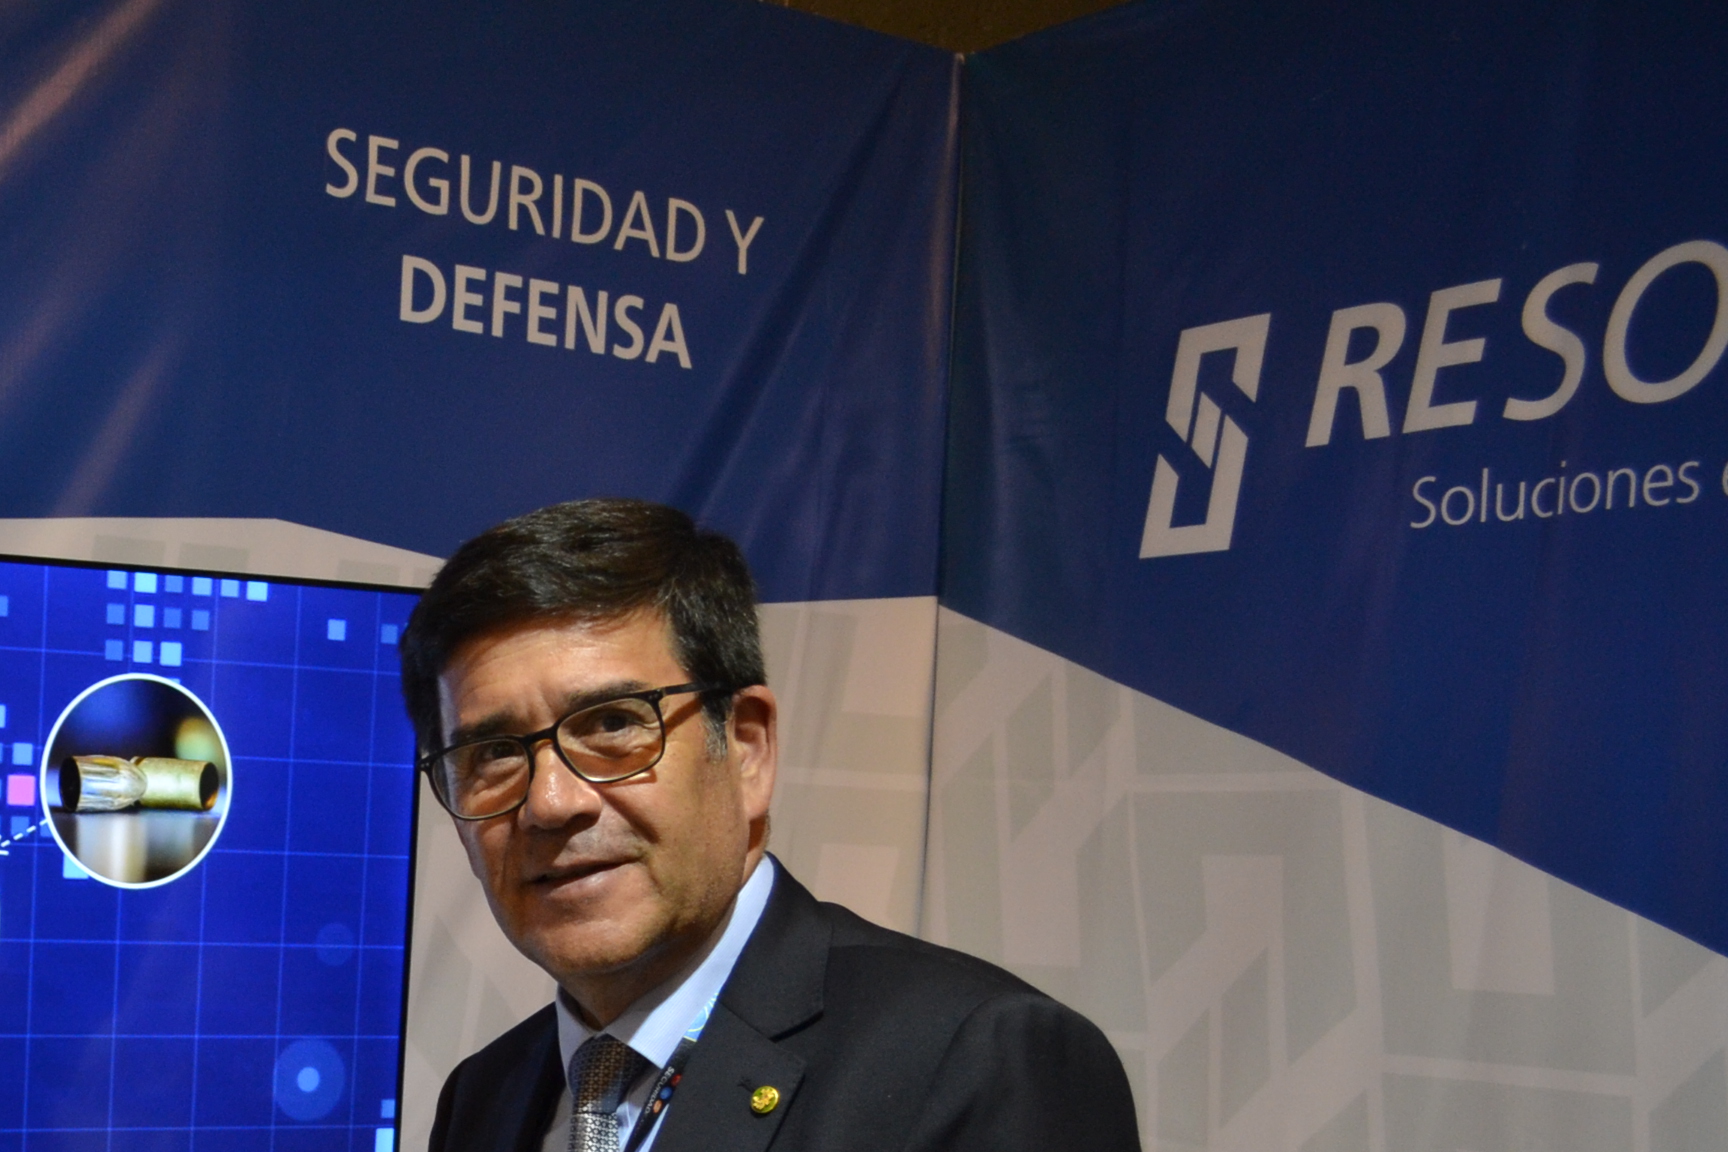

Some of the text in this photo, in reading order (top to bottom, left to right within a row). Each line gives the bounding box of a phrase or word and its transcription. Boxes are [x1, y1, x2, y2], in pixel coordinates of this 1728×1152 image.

[324, 127, 765, 275] SEGURIDAD Y
[398, 254, 693, 370] DEFENSA
[1304, 239, 1728, 449] RESO
[1409, 459, 1700, 529] Soluciones
